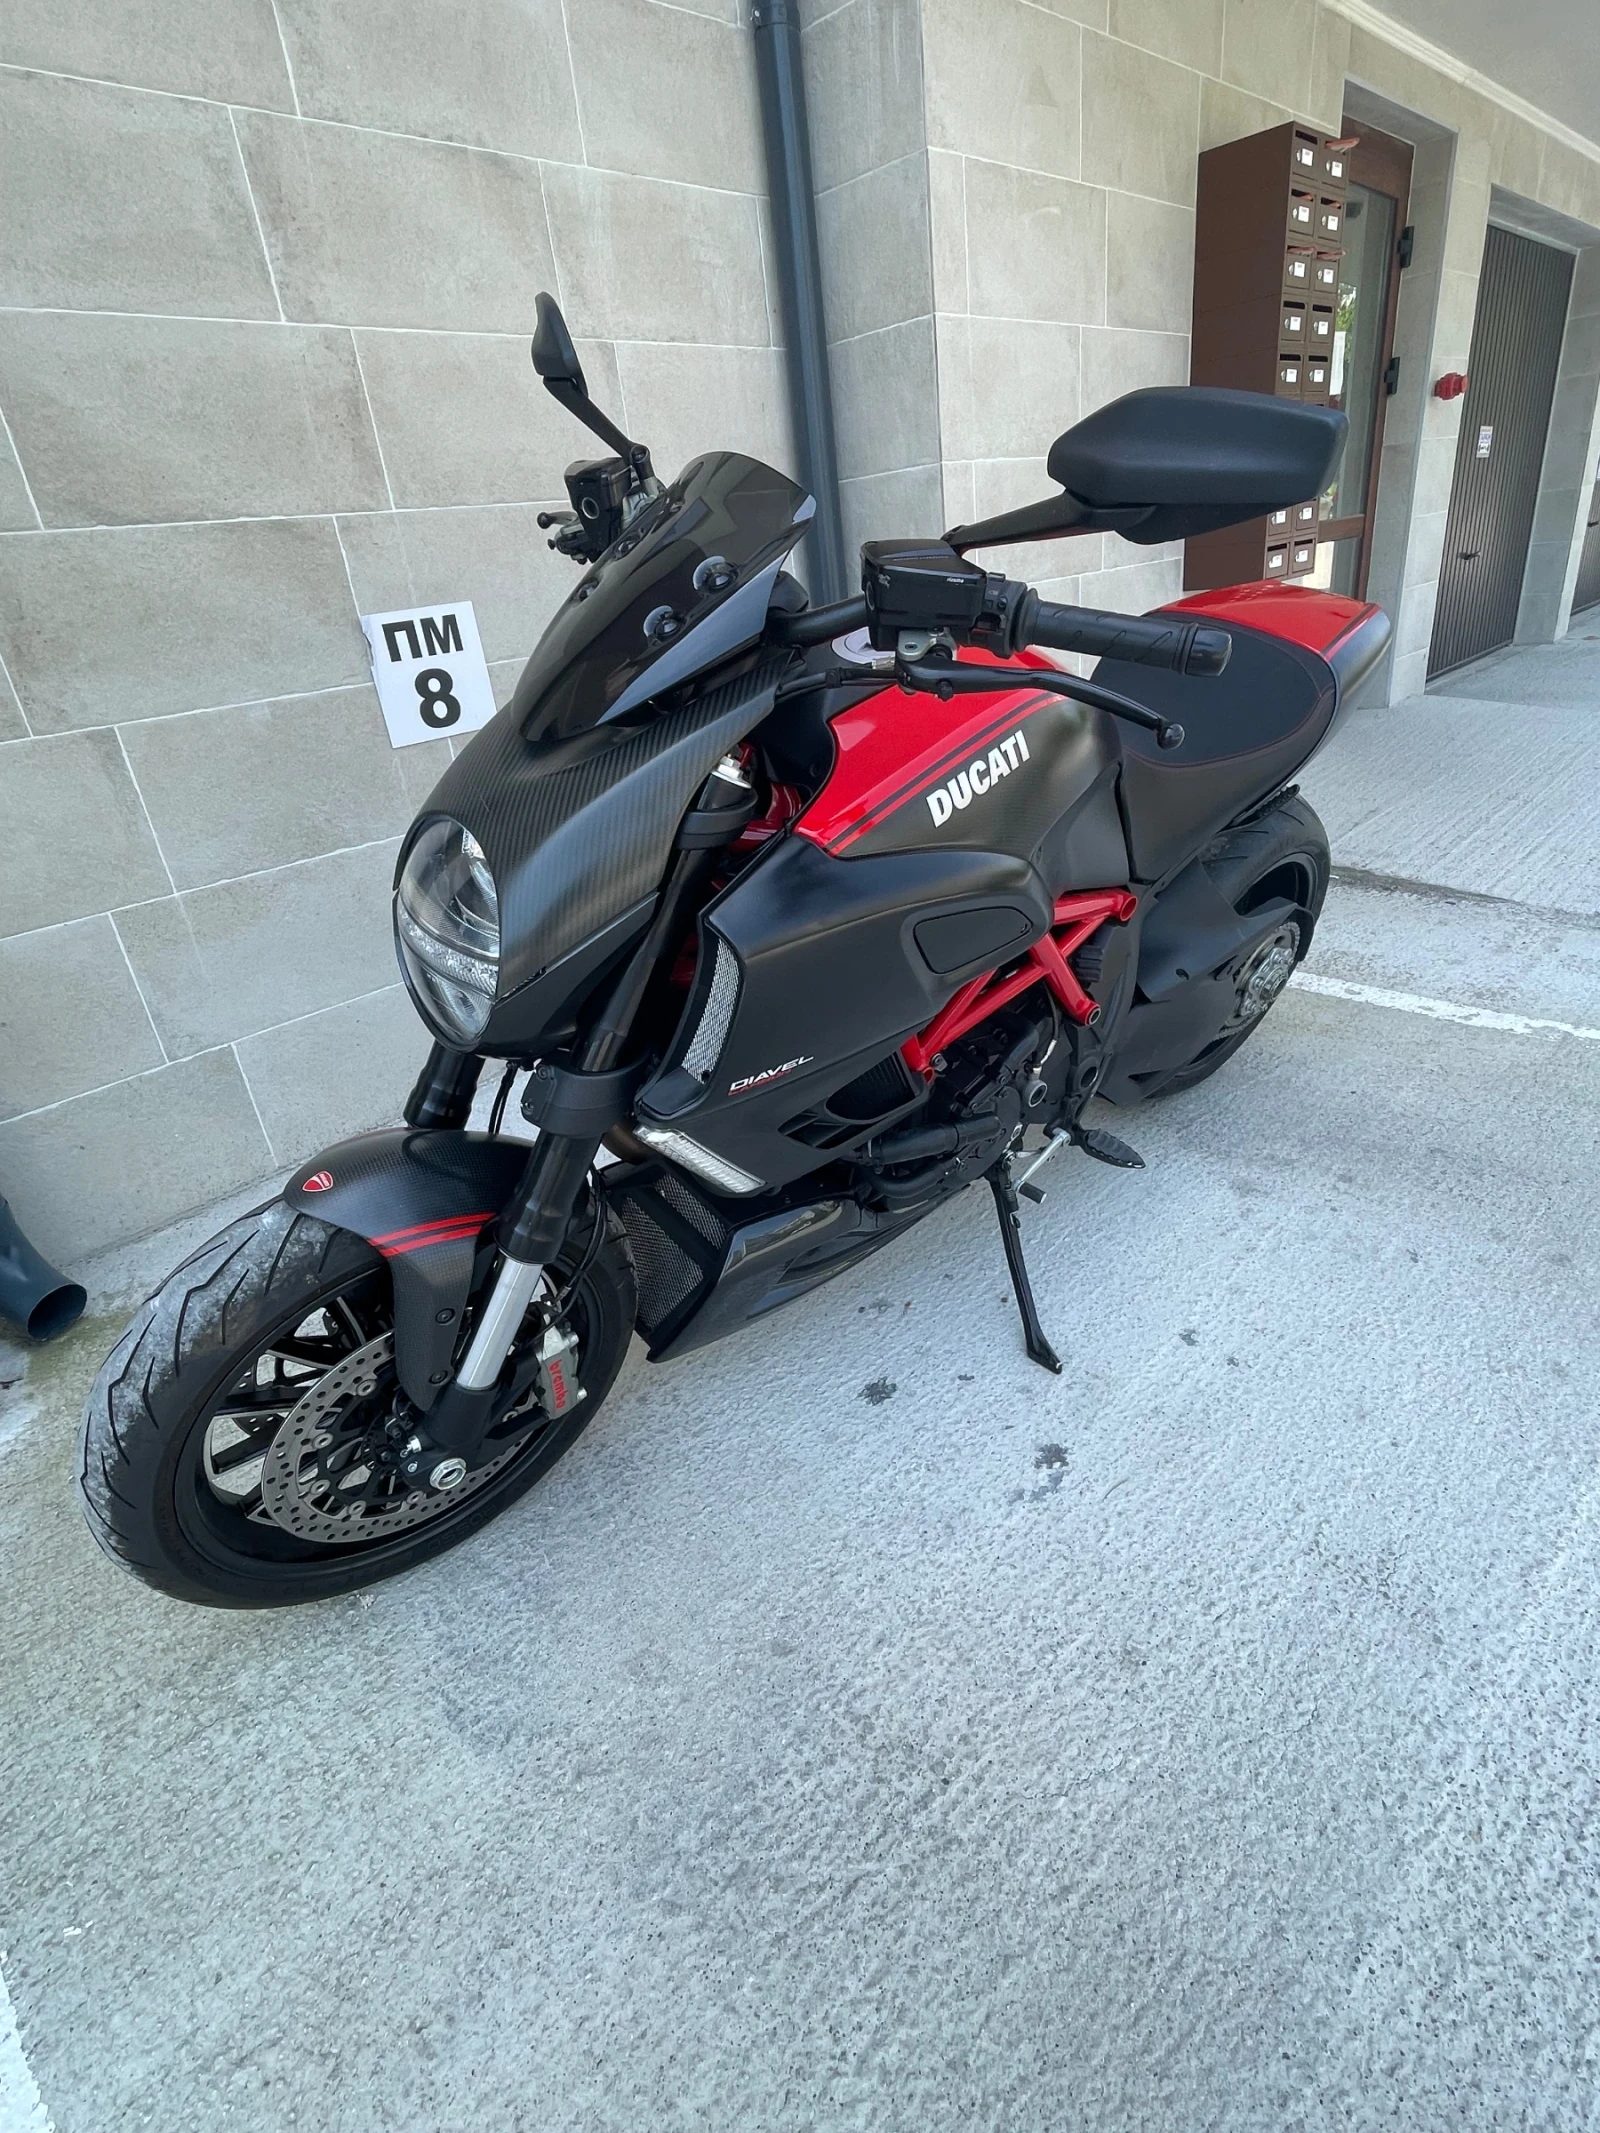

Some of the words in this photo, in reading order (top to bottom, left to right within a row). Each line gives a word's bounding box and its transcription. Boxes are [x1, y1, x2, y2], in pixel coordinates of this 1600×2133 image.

[382, 614, 463, 662] ПМ
[414, 668, 461, 728] 8
[926, 730, 1030, 828] DUCATI
[730, 1056, 814, 1091] DIAVEL
[549, 1359, 569, 1409] brembo
